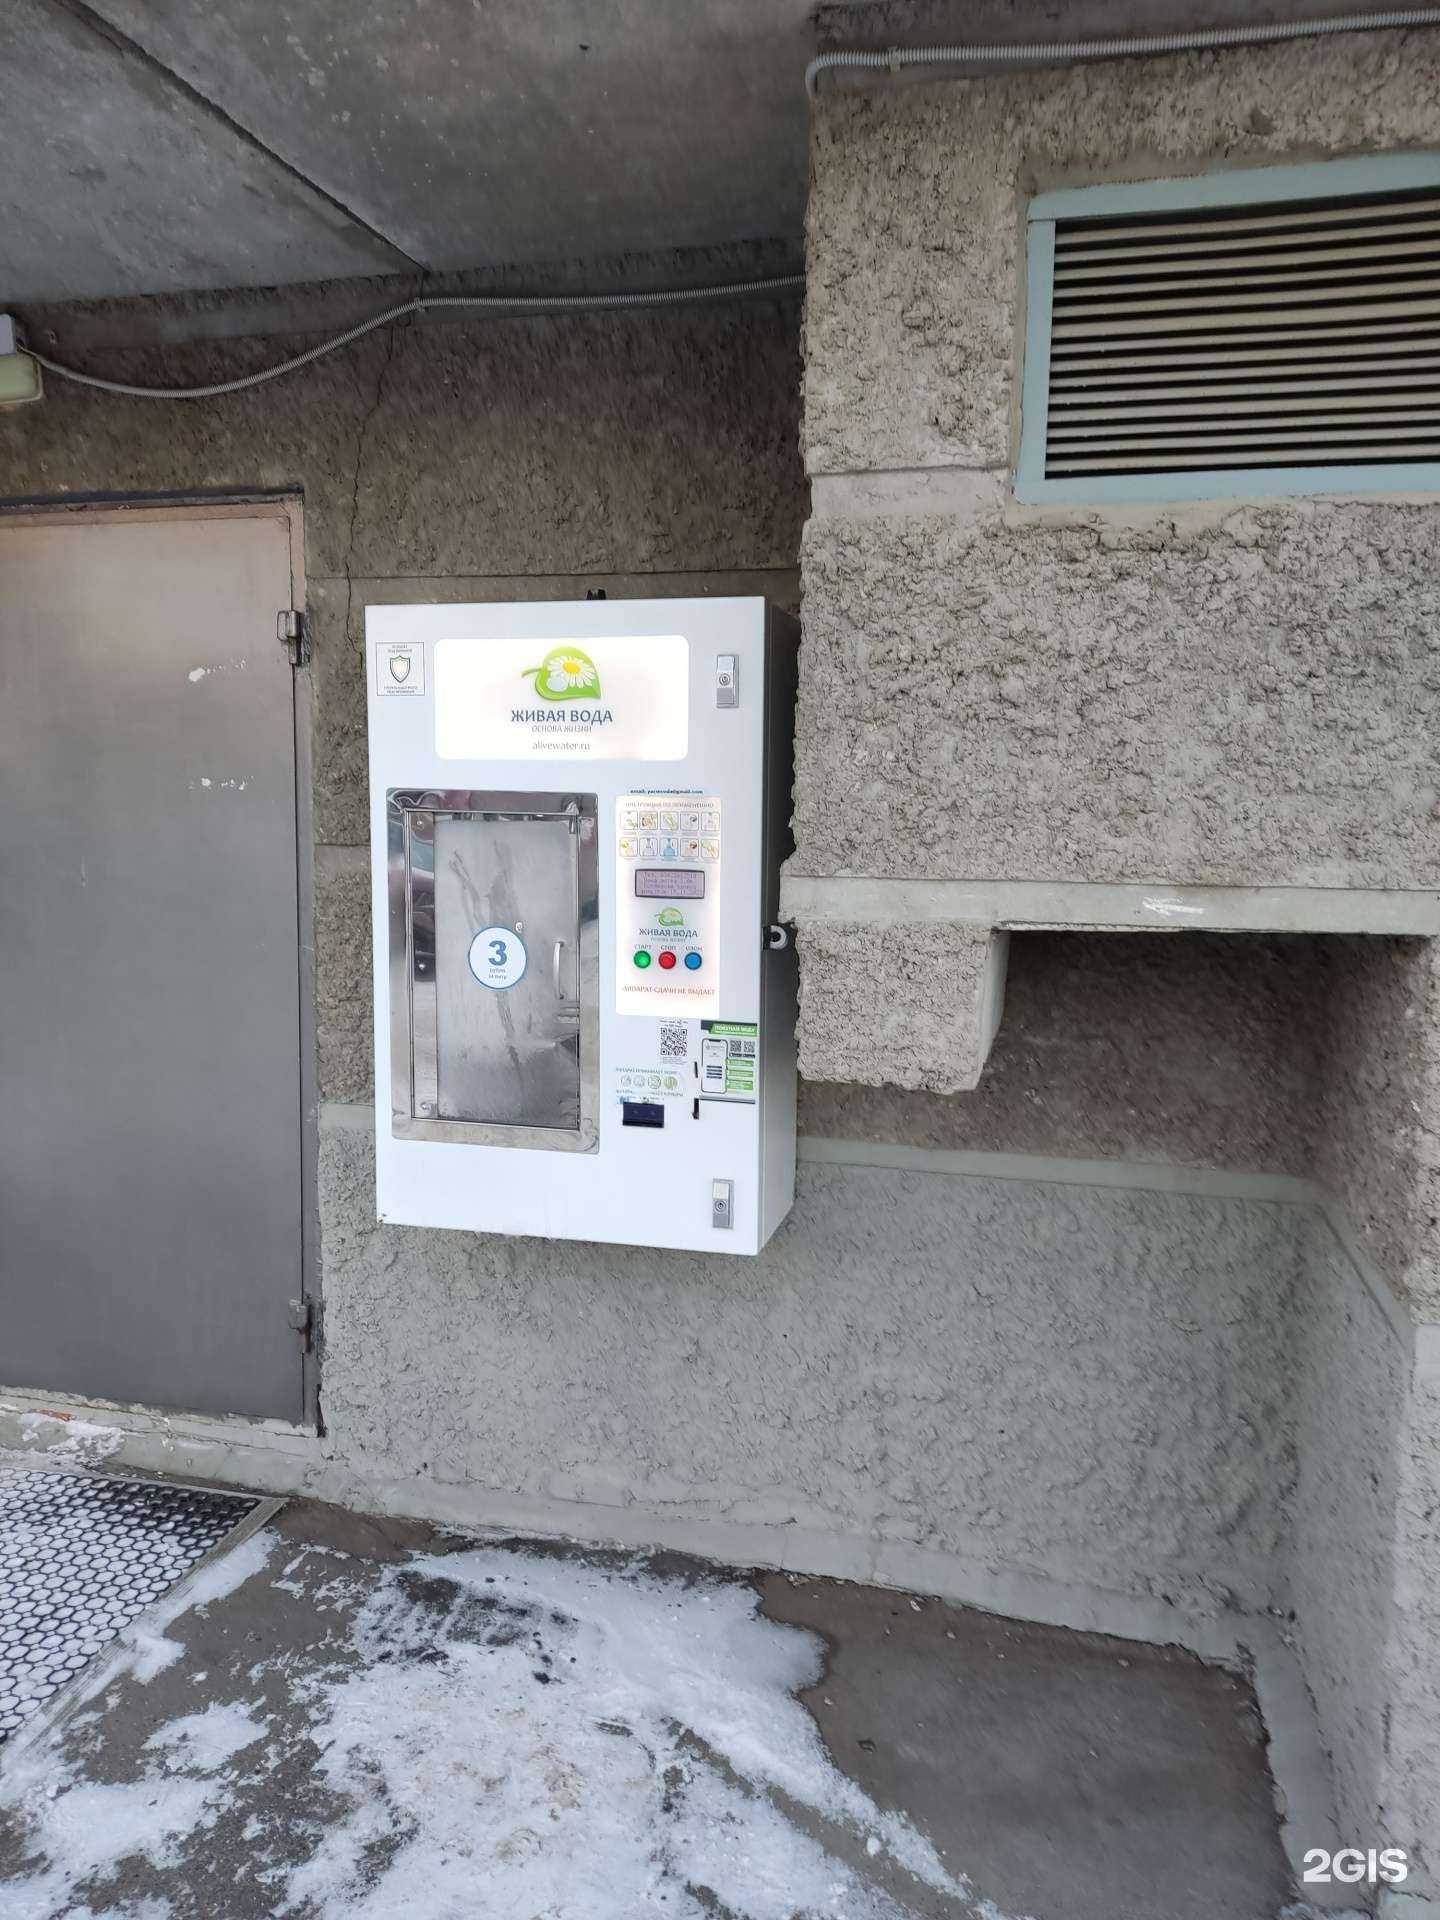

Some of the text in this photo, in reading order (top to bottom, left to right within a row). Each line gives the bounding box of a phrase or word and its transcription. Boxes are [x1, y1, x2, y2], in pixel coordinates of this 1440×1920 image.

[511, 709, 613, 725] ЖИВАЯ ВОДА
[531, 725, 592, 733] ОСНОВА ЖИЗНИ
[532, 740, 591, 750] alivewater.ru
[639, 928, 698, 938] ЖИВАЯ ВОДА
[488, 940, 507, 966] 3
